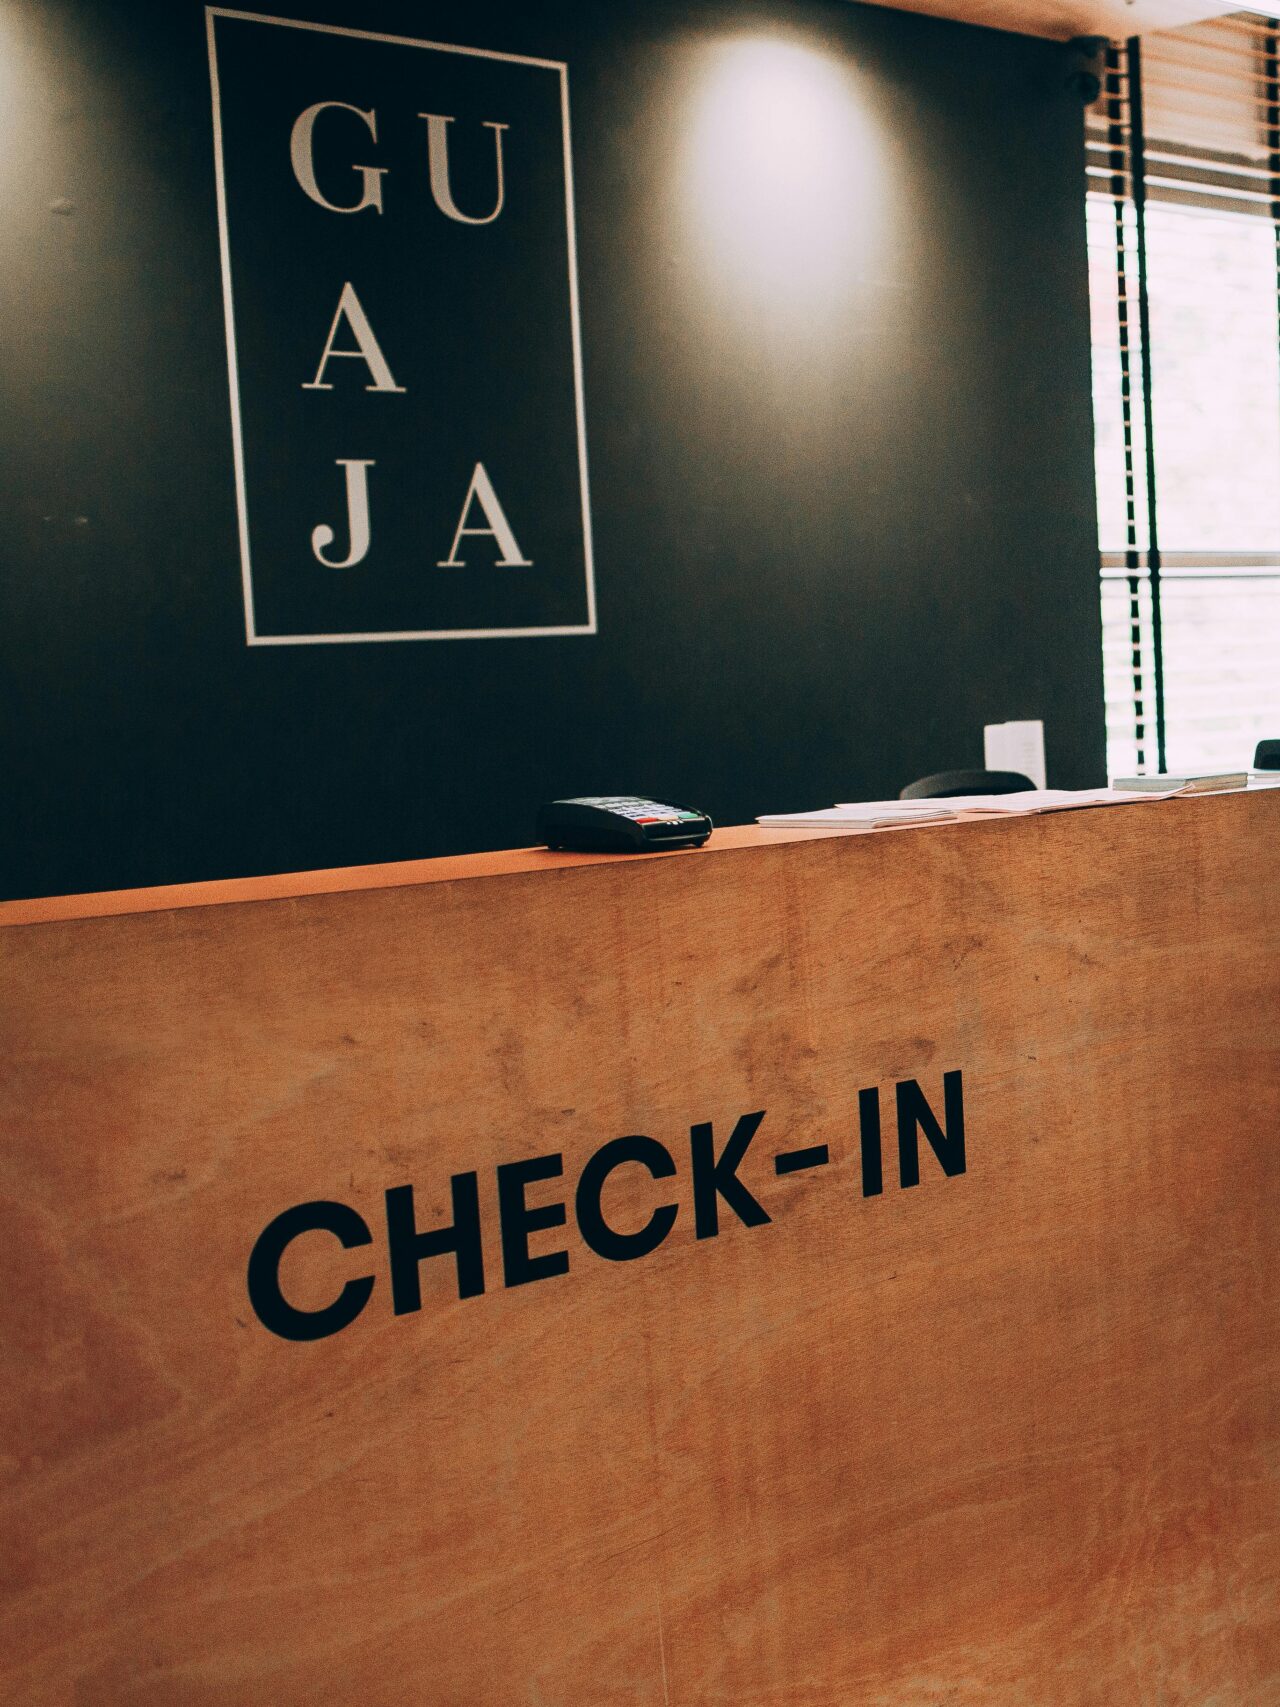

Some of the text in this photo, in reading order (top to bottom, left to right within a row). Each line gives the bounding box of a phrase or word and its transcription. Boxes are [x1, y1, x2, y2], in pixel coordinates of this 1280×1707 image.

[290, 101, 510, 225] GU
[302, 281, 407, 393] A
[311, 458, 534, 569] JA
[247, 1069, 967, 1342] CHECK-IN
